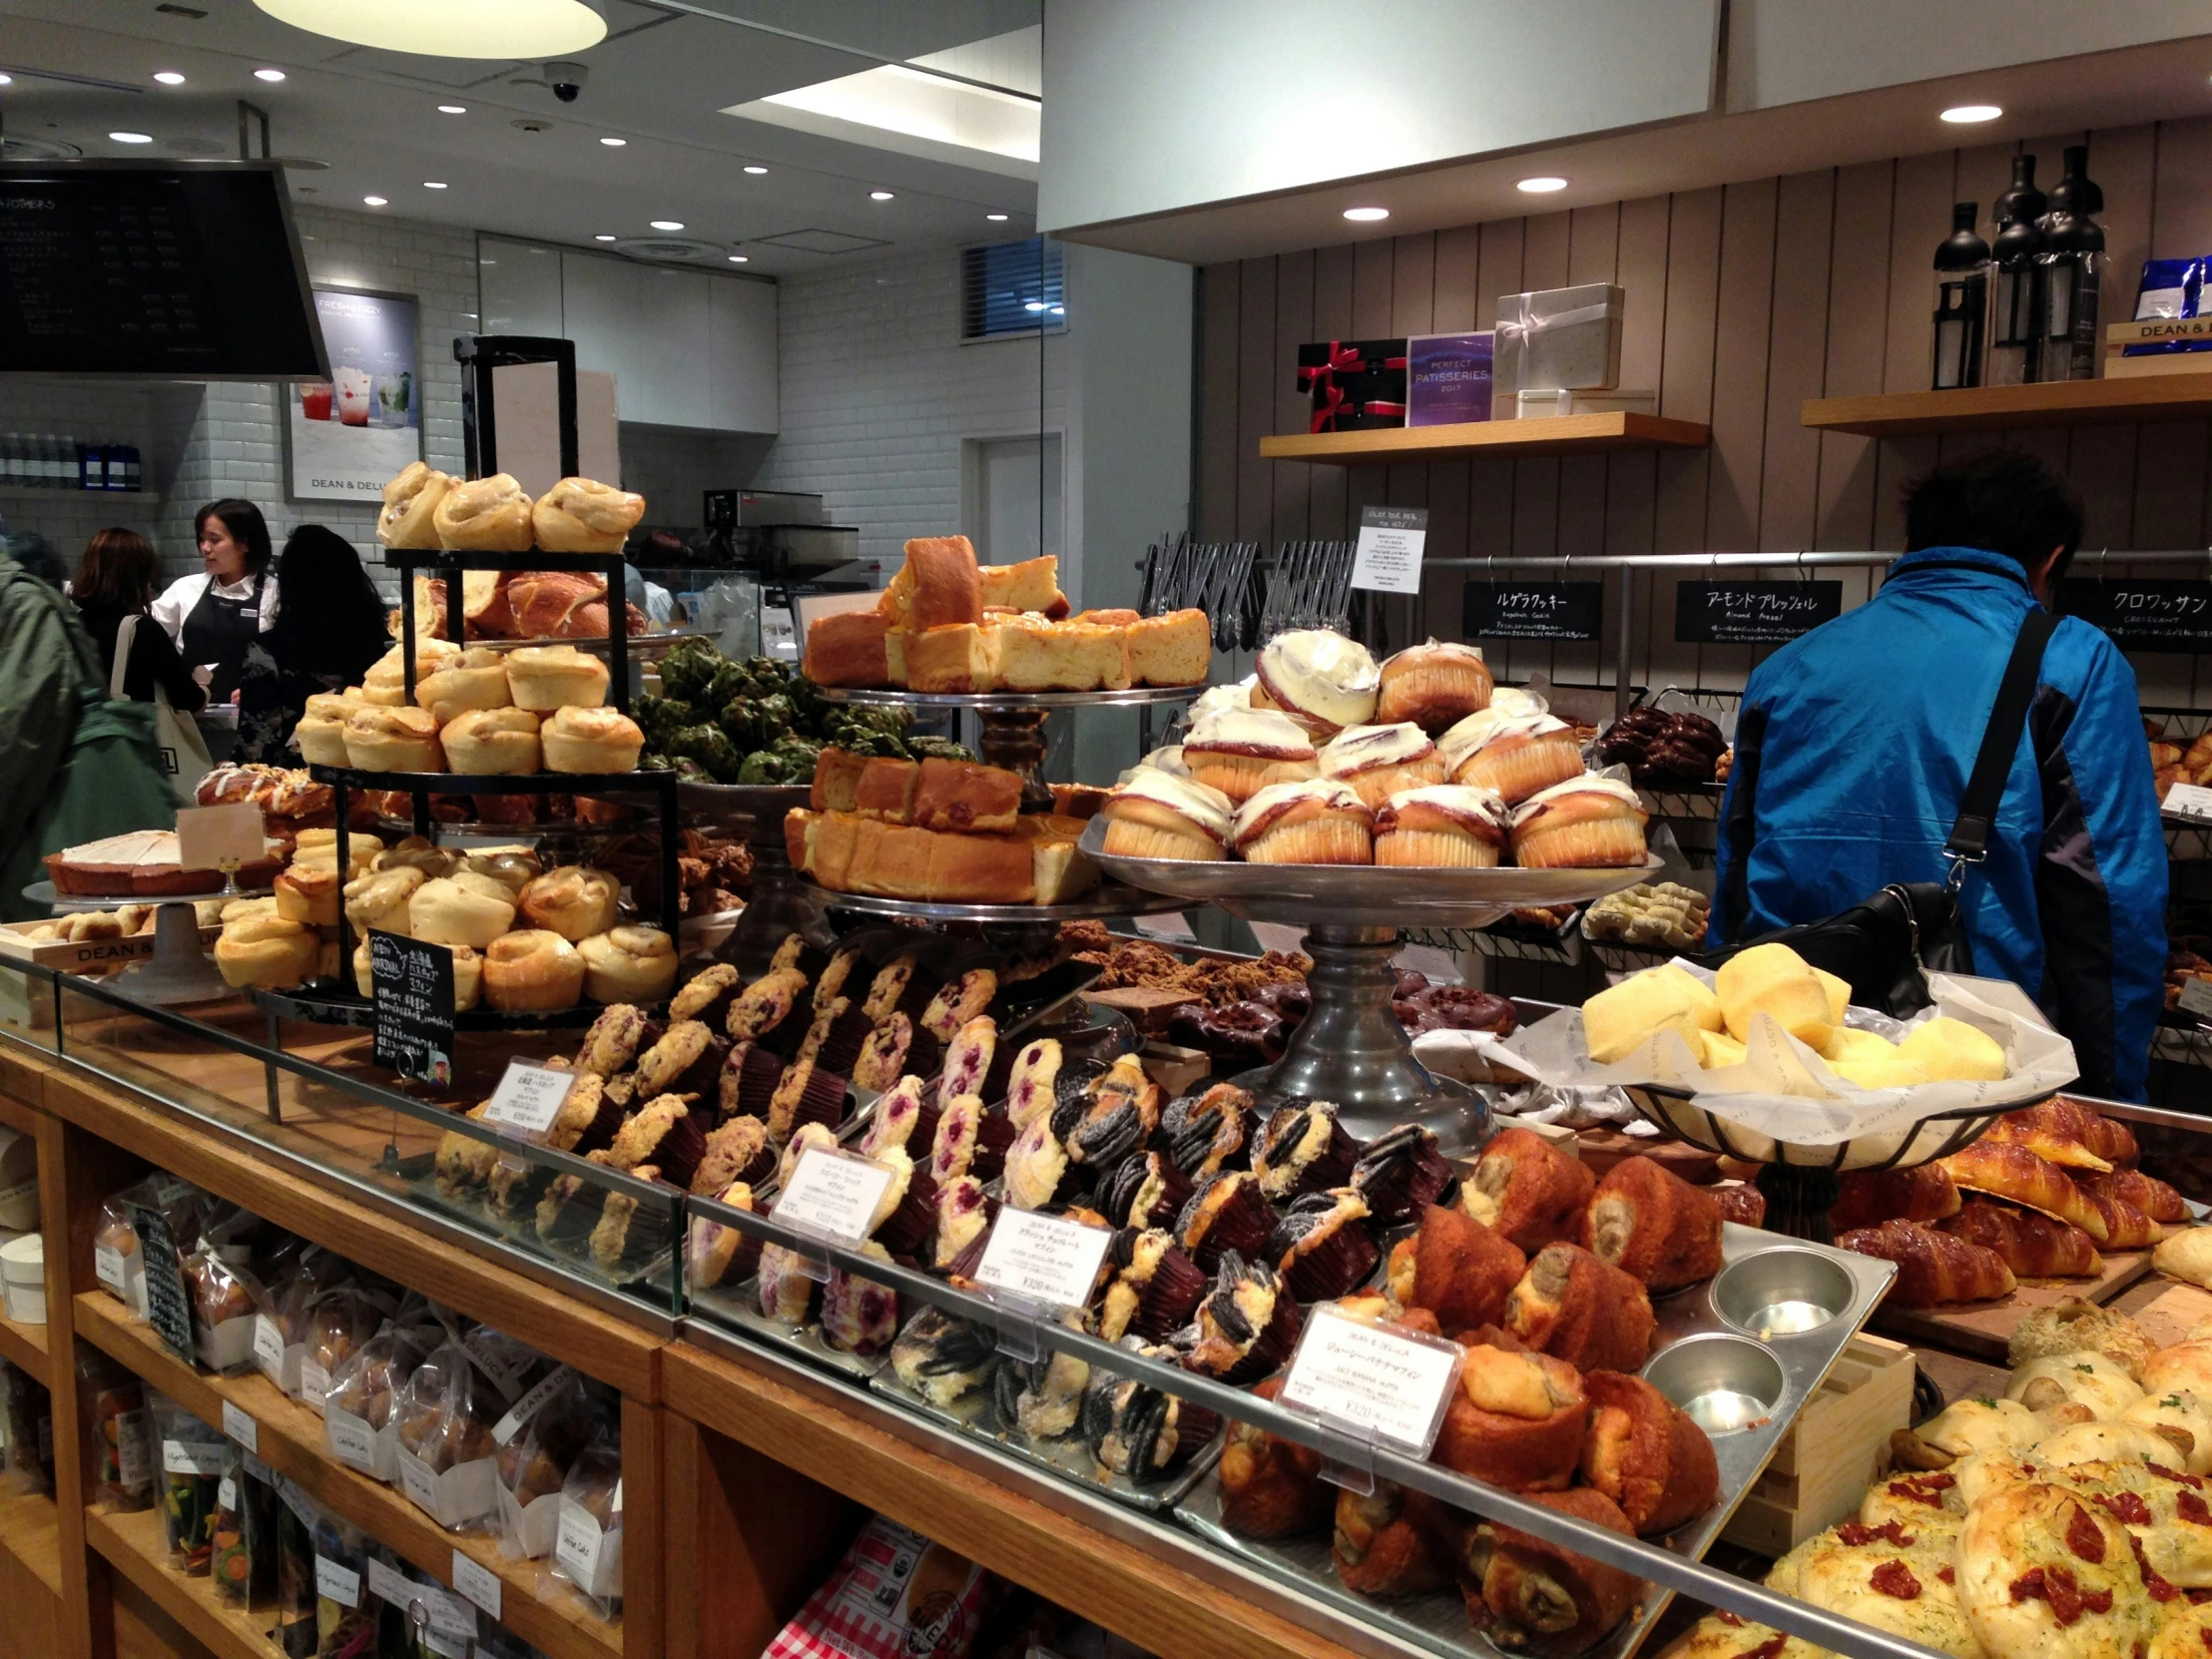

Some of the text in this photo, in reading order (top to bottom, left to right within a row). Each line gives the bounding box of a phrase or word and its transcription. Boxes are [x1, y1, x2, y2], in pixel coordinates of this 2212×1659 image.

[2141, 324, 2187, 336] DEAN
[2193, 323, 2203, 333] &
[1431, 359, 1471, 368] PERFECT
[1416, 370, 1488, 382] PATISSERIES
[311, 479, 343, 488] DEAN
[1497, 593, 1567, 610] ルゲラクッキー
[1707, 592, 1756, 608] アーモンド
[2114, 593, 2207, 613] クロワッサン
[78, 941, 154, 961] DEAN &
[373, 943, 391, 955] NEW
[1034, 1242, 1056, 1254] マフィン
[467, 1342, 504, 1380] DELUCA
[1327, 1341, 1421, 1381] ジューシーバナナマフィン
[513, 1391, 544, 1421] DEAN
[545, 1383, 553, 1392] &
[1347, 1399, 1372, 1417] ¥320
[825, 1630, 840, 1648] Net
